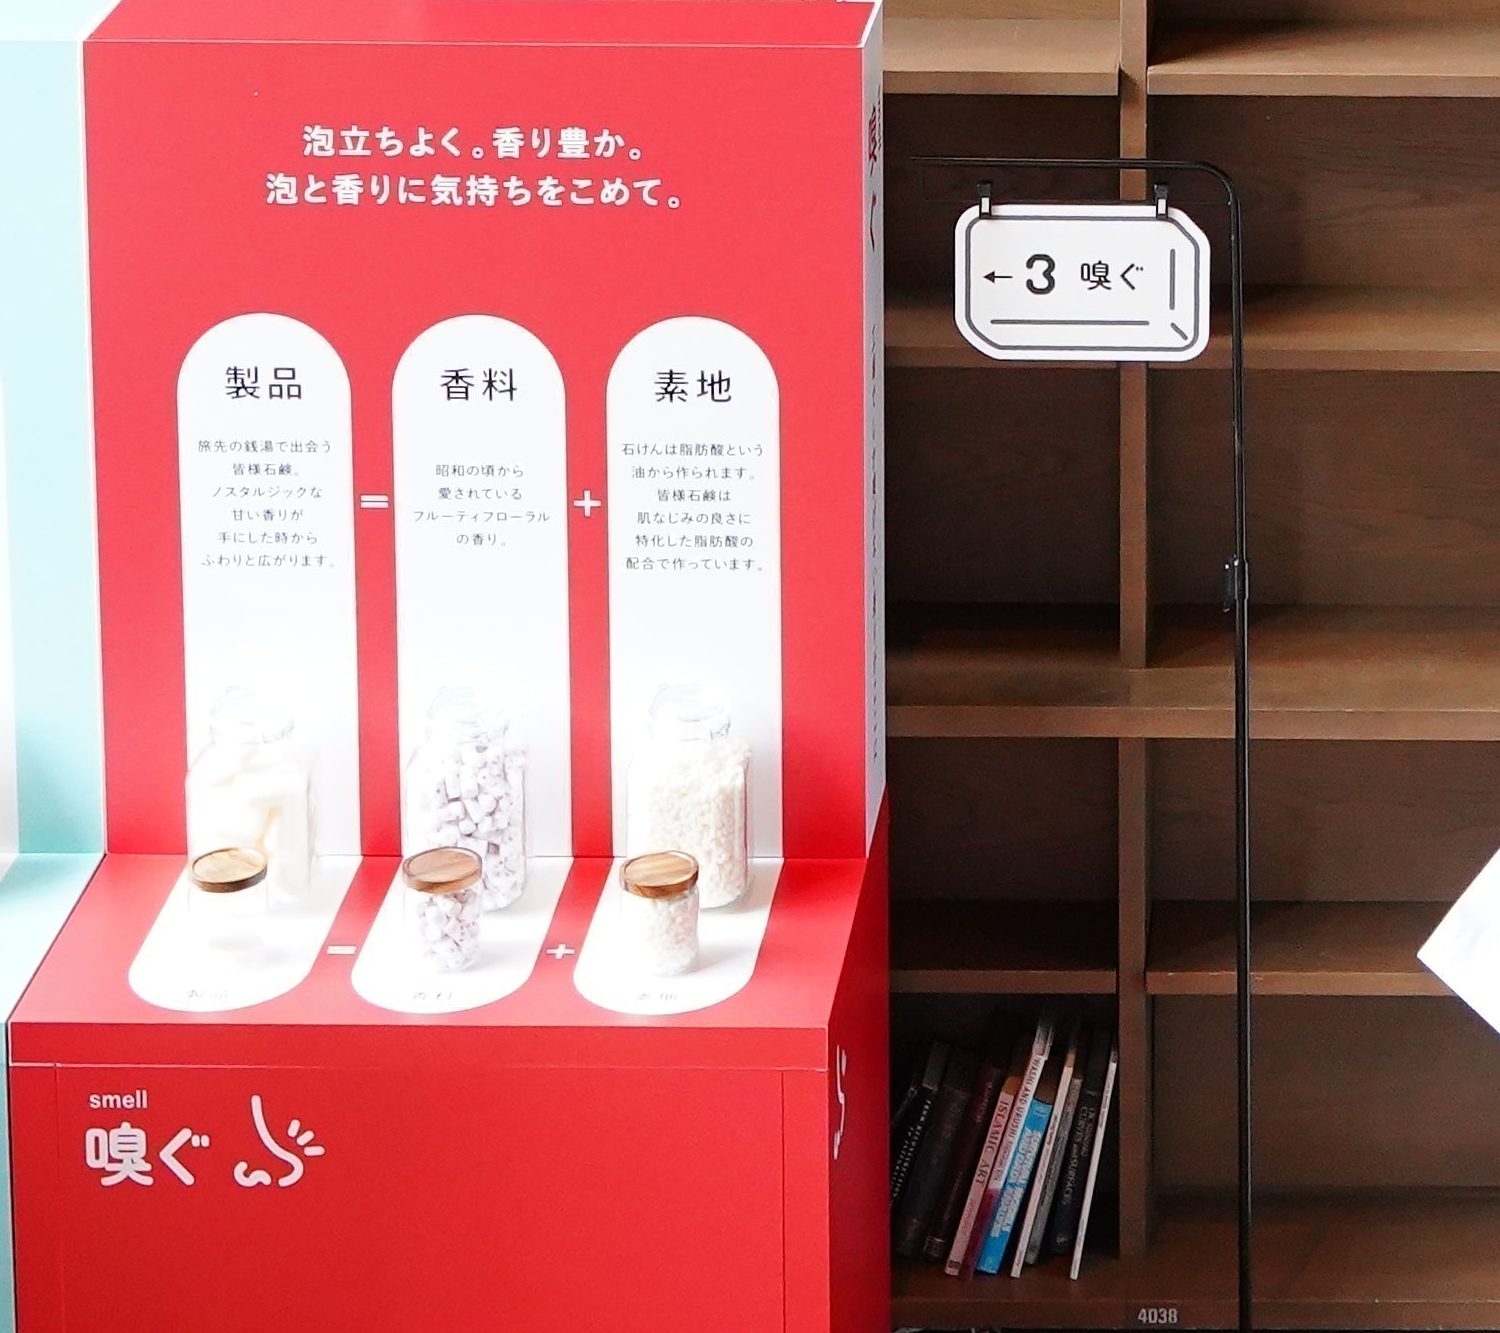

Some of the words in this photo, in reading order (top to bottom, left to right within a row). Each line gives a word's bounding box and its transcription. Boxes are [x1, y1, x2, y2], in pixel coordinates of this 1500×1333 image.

[302, 126, 643, 162] 泡立ちよく。香り豊か。
[264, 172, 682, 209] 泡と香りに気持ちをこめて。
[1025, 253, 1056, 295] 3
[1080, 260, 1144, 291] 嗅ぐ
[224, 366, 302, 401] 製品
[439, 368, 518, 402] 香料
[654, 369, 732, 404] 素地
[212, 485, 323, 500] ノスタルジックな
[438, 486, 522, 502] 愛されている
[88, 1091, 148, 1110] smell
[84, 1121, 211, 1188] 嗅ぐ
[1137, 1307, 1179, 1325] 4038
